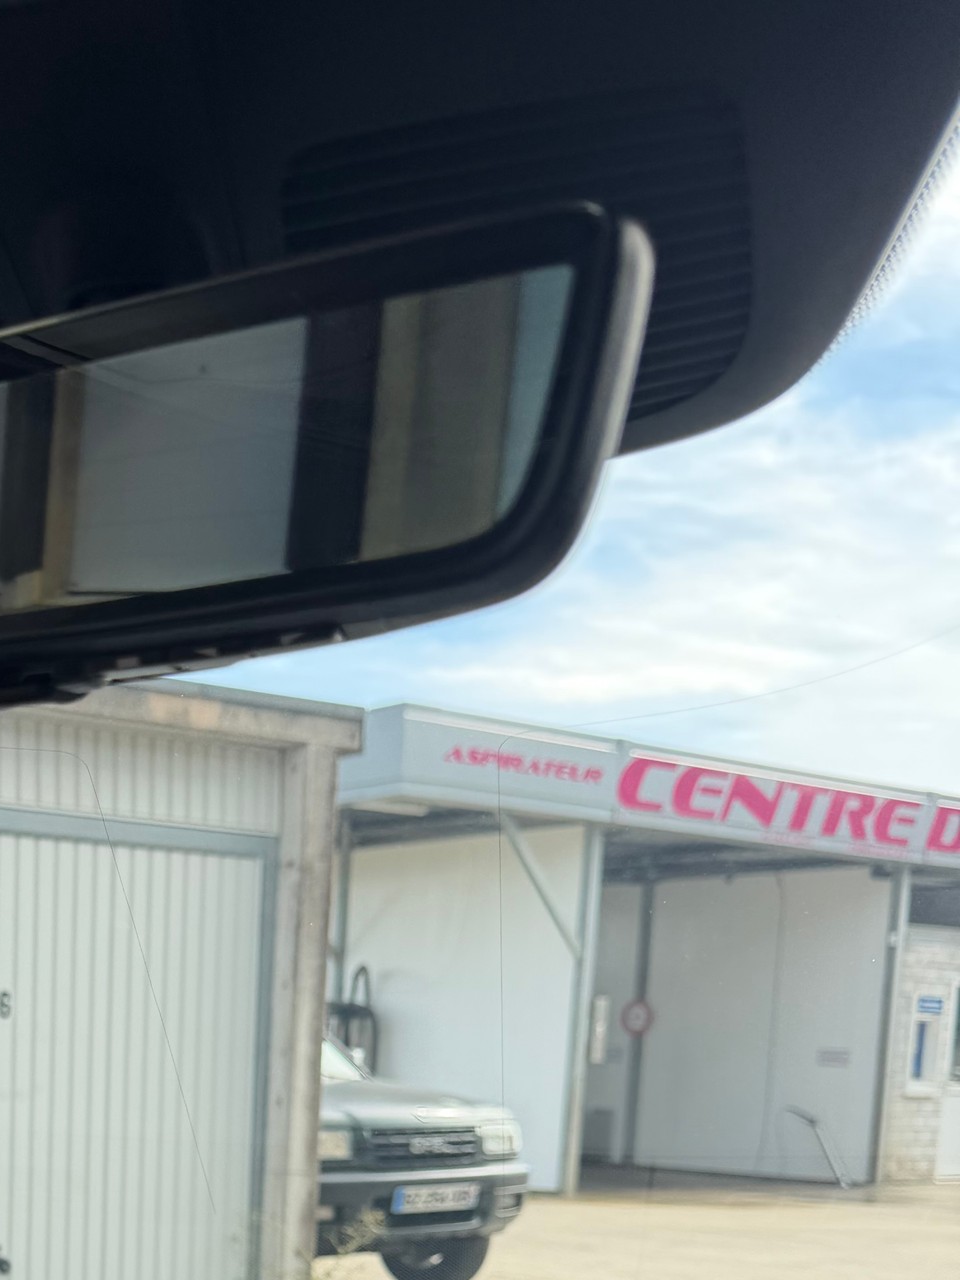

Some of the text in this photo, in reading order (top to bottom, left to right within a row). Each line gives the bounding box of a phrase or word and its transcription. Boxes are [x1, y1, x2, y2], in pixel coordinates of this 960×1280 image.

[444, 747, 605, 784] ASPIRATEUR
[617, 756, 922, 847] CENTRE
[0, 991, 11, 1019] 6
